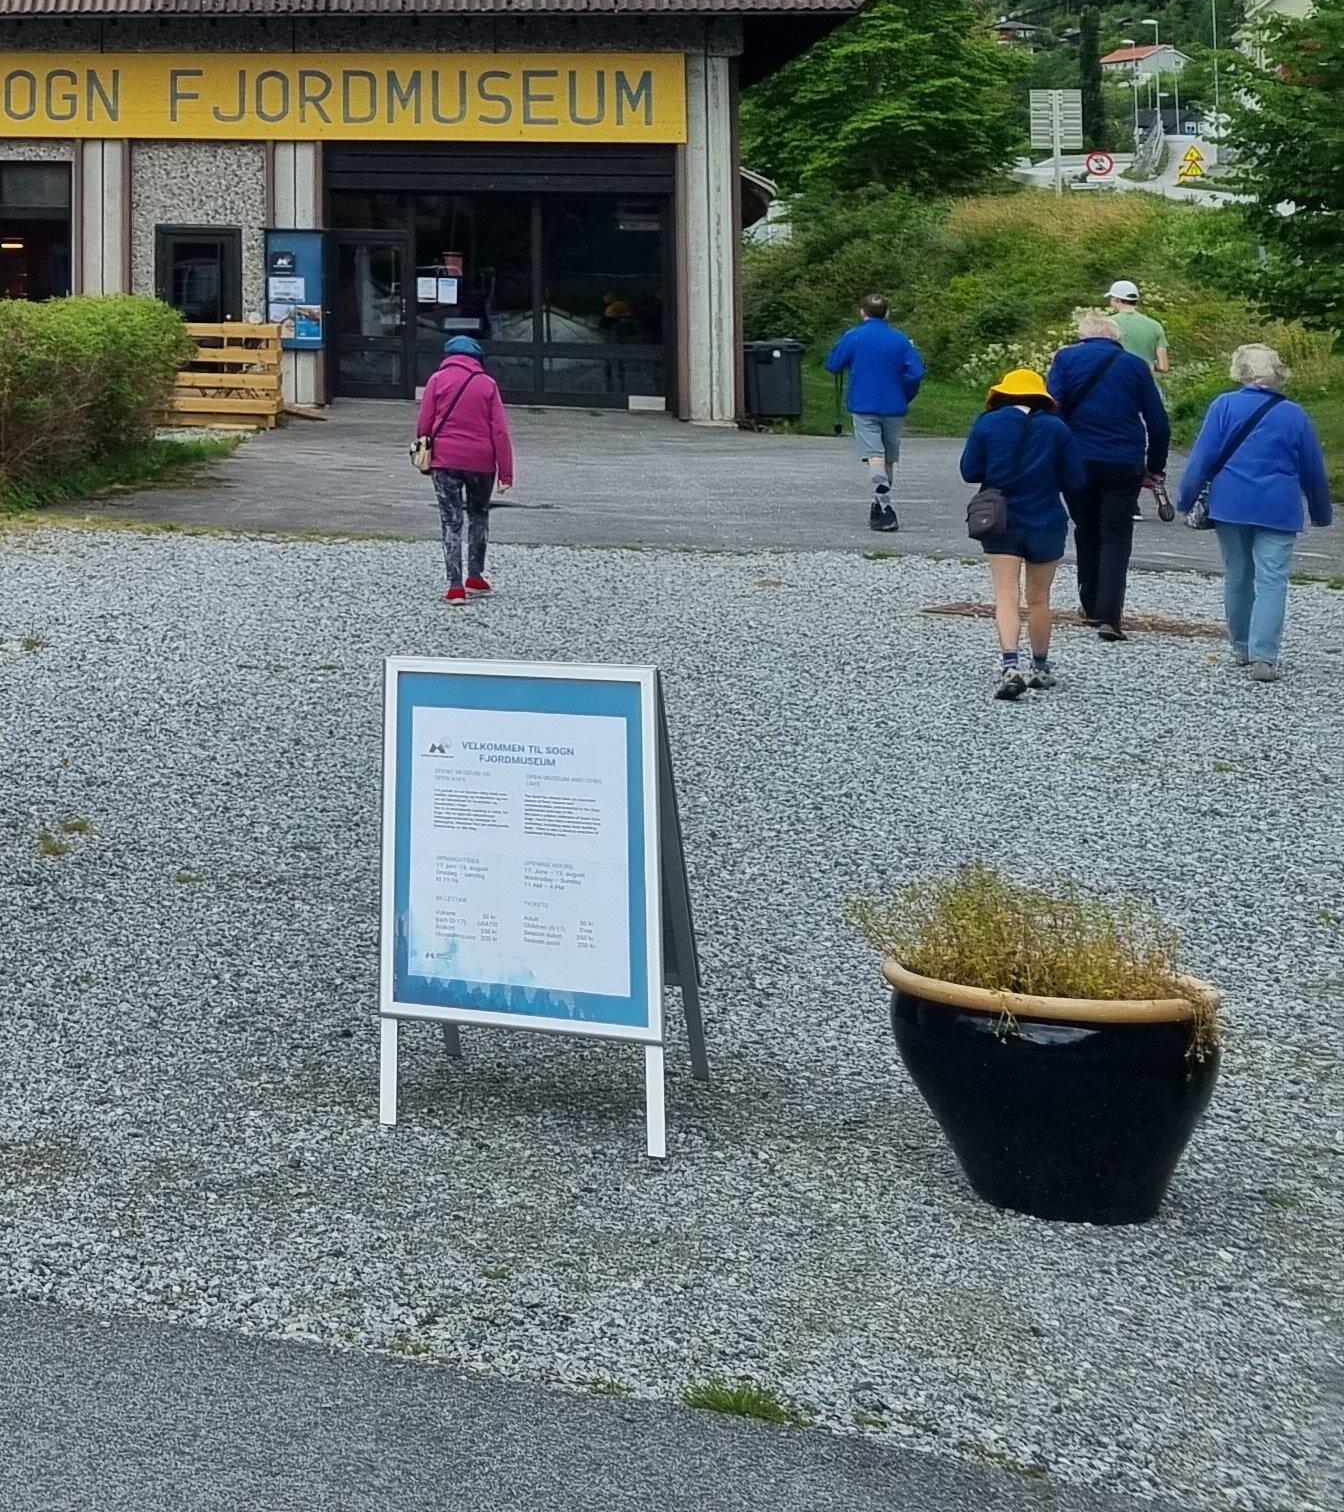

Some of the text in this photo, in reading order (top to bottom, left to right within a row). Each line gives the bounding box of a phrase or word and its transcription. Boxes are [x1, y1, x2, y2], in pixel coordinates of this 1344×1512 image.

[169, 68, 654, 127] FJORDMUSEUM
[461, 741, 575, 757] VELKOMMEN TIL SOGN
[479, 754, 556, 767] FJORDMUSEUM
